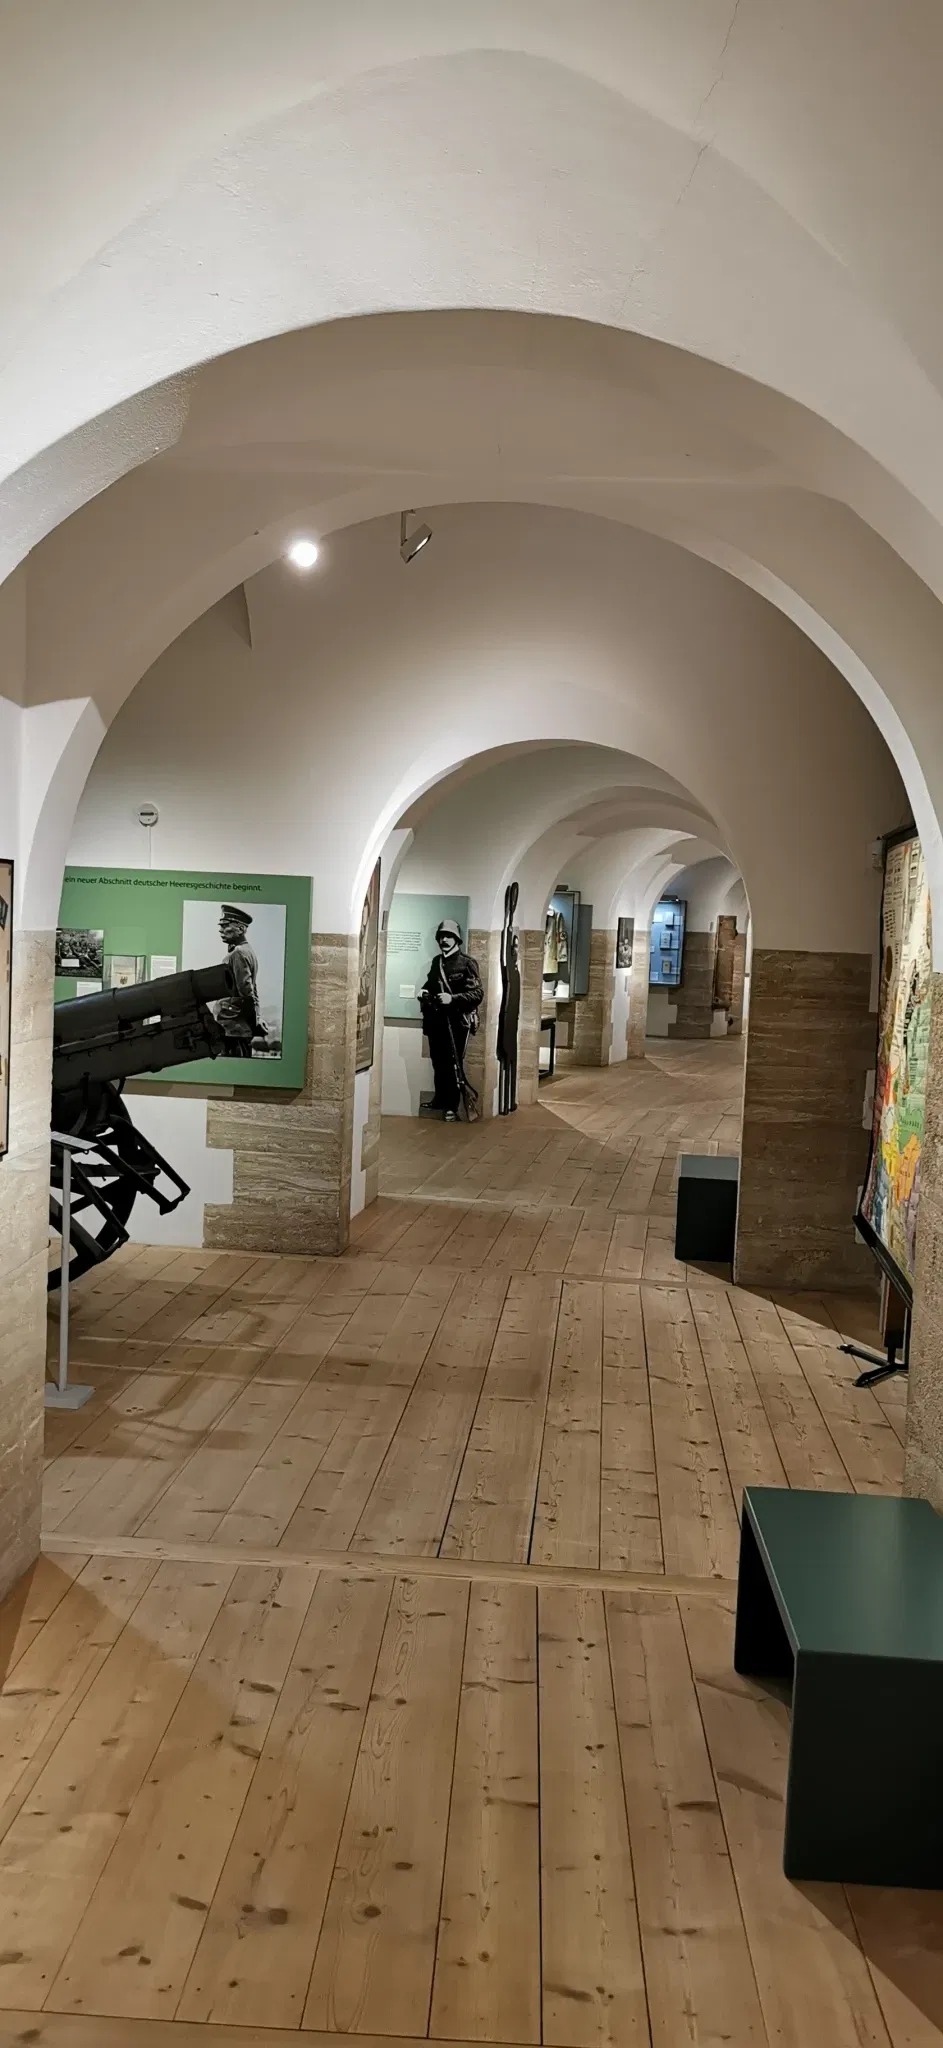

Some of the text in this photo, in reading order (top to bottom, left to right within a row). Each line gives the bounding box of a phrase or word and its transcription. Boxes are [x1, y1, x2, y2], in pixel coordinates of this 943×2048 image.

[98, 877, 132, 885] Abschnitt
[133, 878, 168, 887] deutscher
[169, 880, 231, 890] Heeresgeschichte
[232, 883, 263, 892] beginnt.
